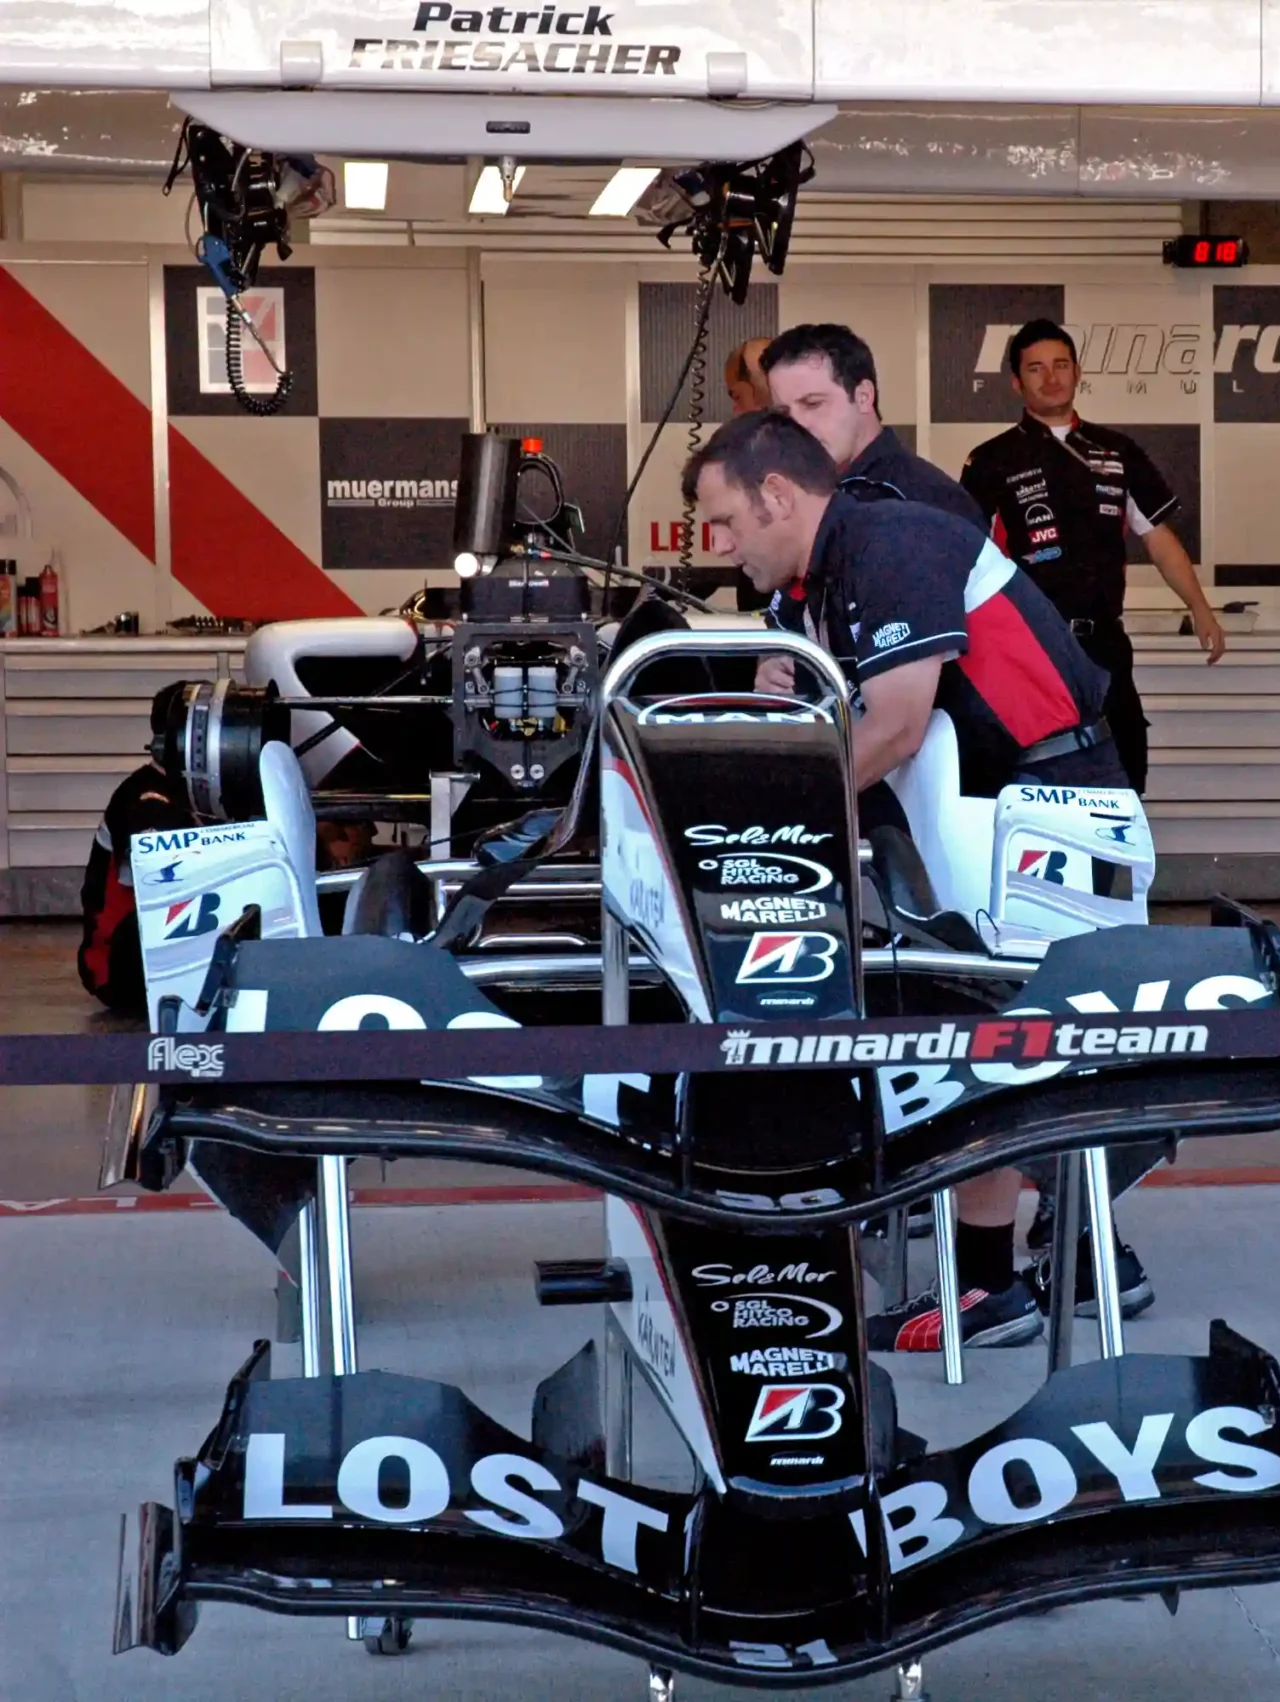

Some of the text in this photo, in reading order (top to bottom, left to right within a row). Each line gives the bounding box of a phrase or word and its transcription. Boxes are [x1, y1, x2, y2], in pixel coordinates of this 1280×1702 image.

[412, 1, 615, 36] Patrick
[347, 38, 682, 75] FRIESACHER
[377, 498, 415, 508] Group
[1032, 527, 1058, 543] JVC
[655, 712, 816, 724] MAN
[1020, 787, 1077, 805] SMP
[1078, 798, 1121, 809] BANK
[137, 831, 246, 854] SMP BANK
[722, 858, 761, 869] SGL
[721, 866, 783, 876] HITCO
[720, 874, 800, 885] RACING
[147, 1036, 224, 1072] flex
[734, 1299, 772, 1310] SGL
[733, 1308, 793, 1318] HITCO
[732, 1315, 810, 1328] RACING
[243, 1432, 669, 1575] LOST
